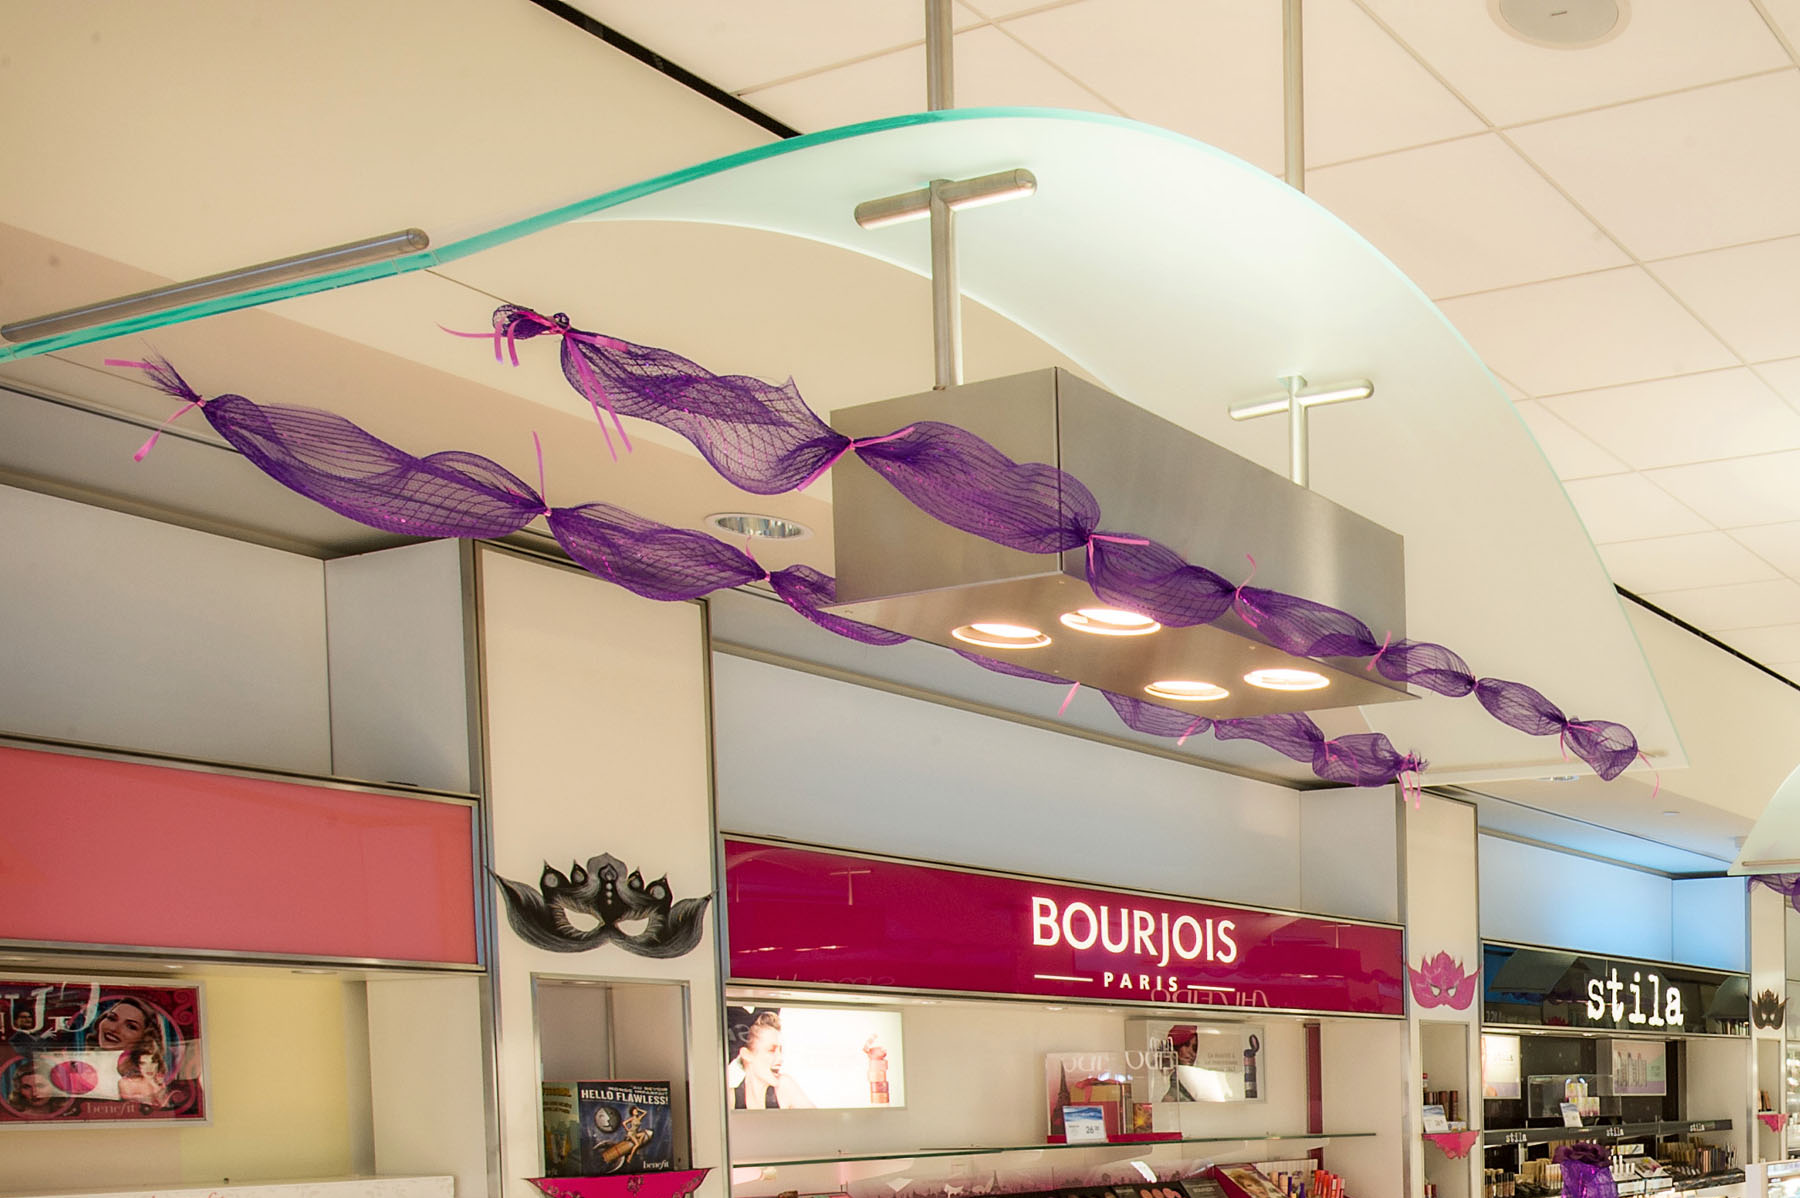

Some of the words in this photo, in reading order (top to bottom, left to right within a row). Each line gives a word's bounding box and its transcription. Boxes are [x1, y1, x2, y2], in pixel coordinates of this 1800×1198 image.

[1031, 896, 1237, 967] BOURJOIS
[1103, 972, 1178, 992] PARIS
[1587, 967, 1684, 1027] stila
[581, 1089, 614, 1100] HELLO
[616, 1092, 669, 1105] FLAWLESS!
[87, 1100, 135, 1116] benefit
[1606, 1127, 1624, 1137] stila
[1689, 1122, 1705, 1132] stila
[1505, 1131, 1527, 1143] stila
[643, 1160, 669, 1170] benefit
